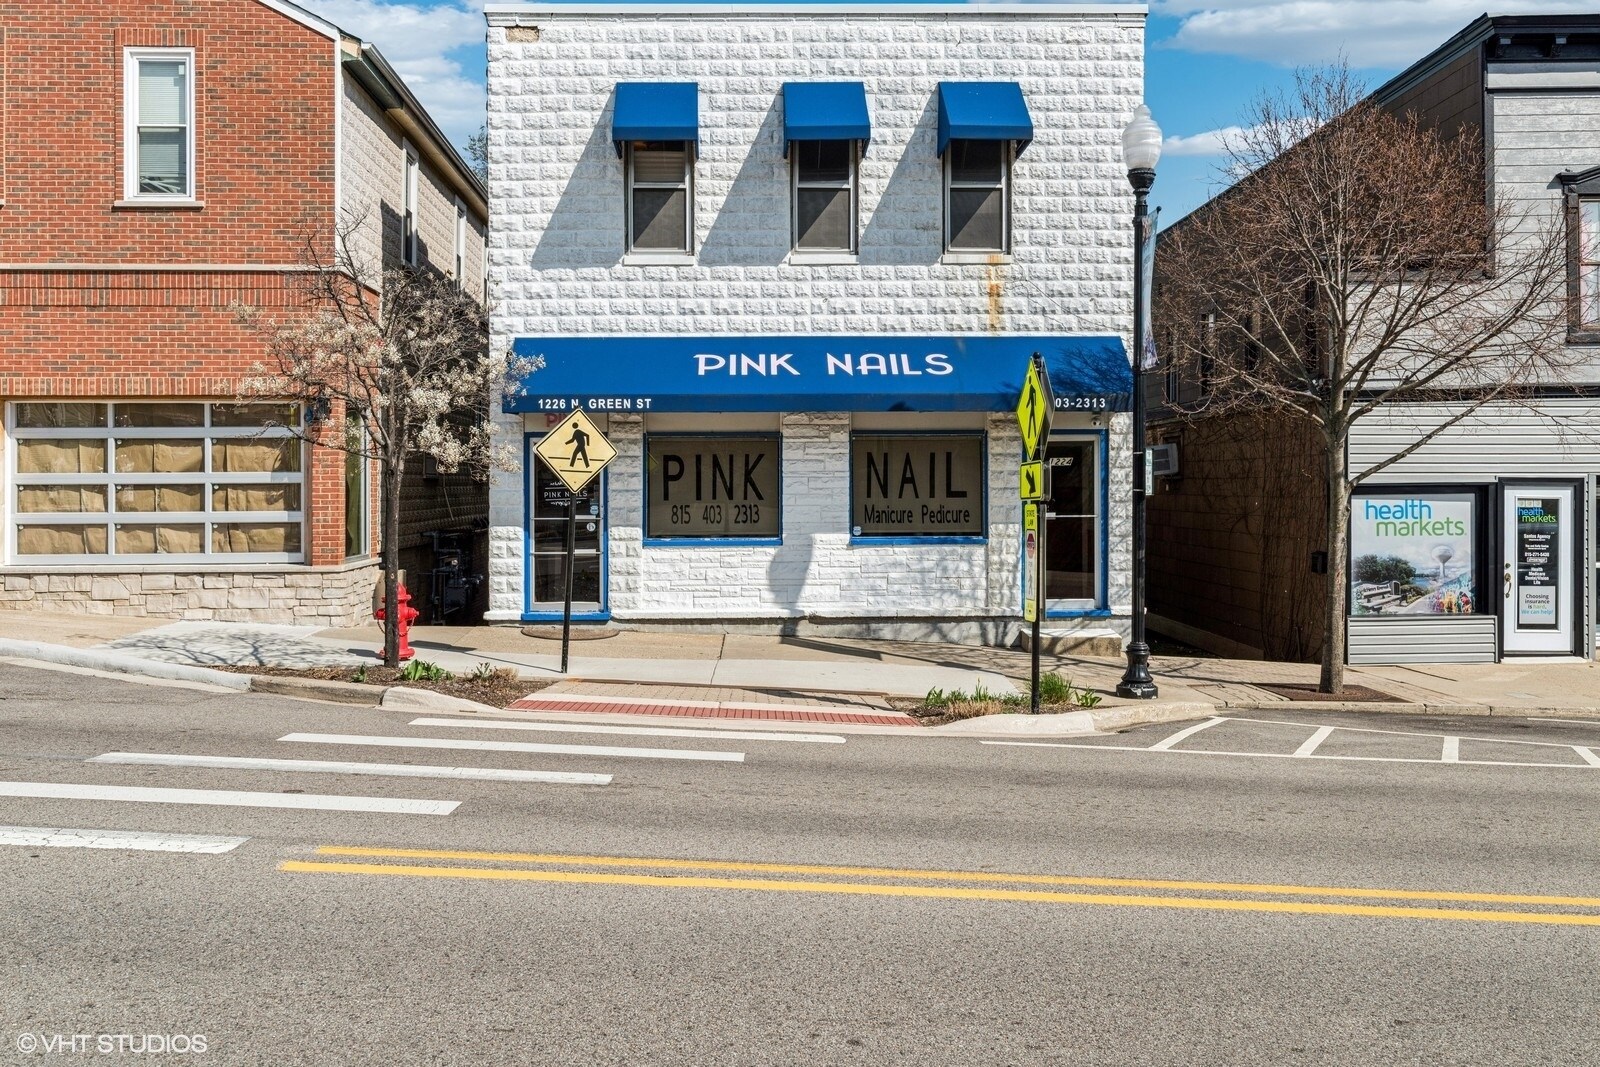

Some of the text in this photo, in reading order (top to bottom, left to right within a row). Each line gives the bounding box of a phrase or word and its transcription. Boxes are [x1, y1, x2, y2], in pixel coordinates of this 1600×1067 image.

[693, 353, 954, 377] PINK NAILS
[537, 399, 566, 409] 1226
[588, 399, 631, 409] GREEN
[636, 399, 652, 409] ST
[1055, 397, 1106, 408] 03-2313
[662, 453, 766, 501] PINK
[866, 451, 968, 499] NAIL
[671, 504, 760, 525] 815 403 2313
[864, 503, 970, 525] Manicure Pedicure
[1365, 499, 1432, 520] health
[1518, 507, 1544, 516] health
[1522, 514, 1556, 523] markets
[1376, 517, 1465, 537] markets
